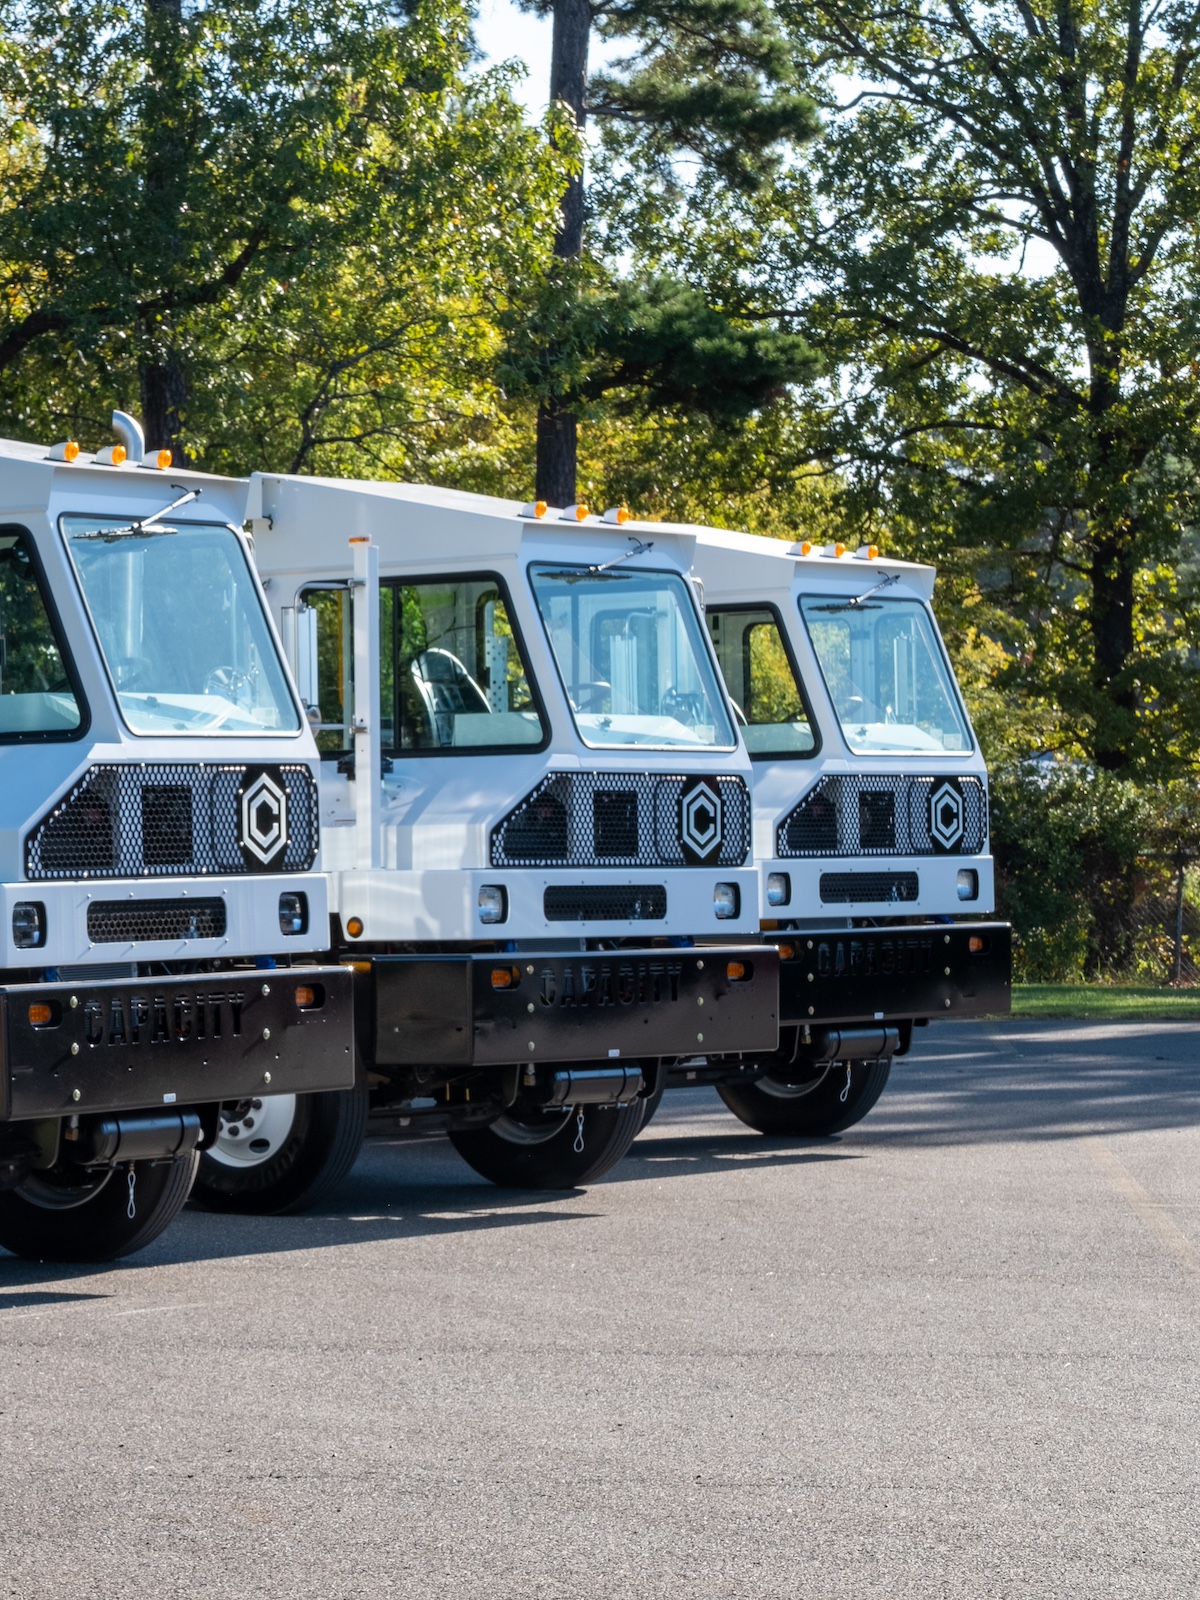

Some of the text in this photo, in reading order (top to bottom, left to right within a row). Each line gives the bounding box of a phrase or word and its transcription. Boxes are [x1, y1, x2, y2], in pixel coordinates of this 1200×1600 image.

[817, 937, 933, 978] CAPACITY
[539, 961, 683, 1008] CAPACITY
[84, 991, 246, 1049] CAPACITY
